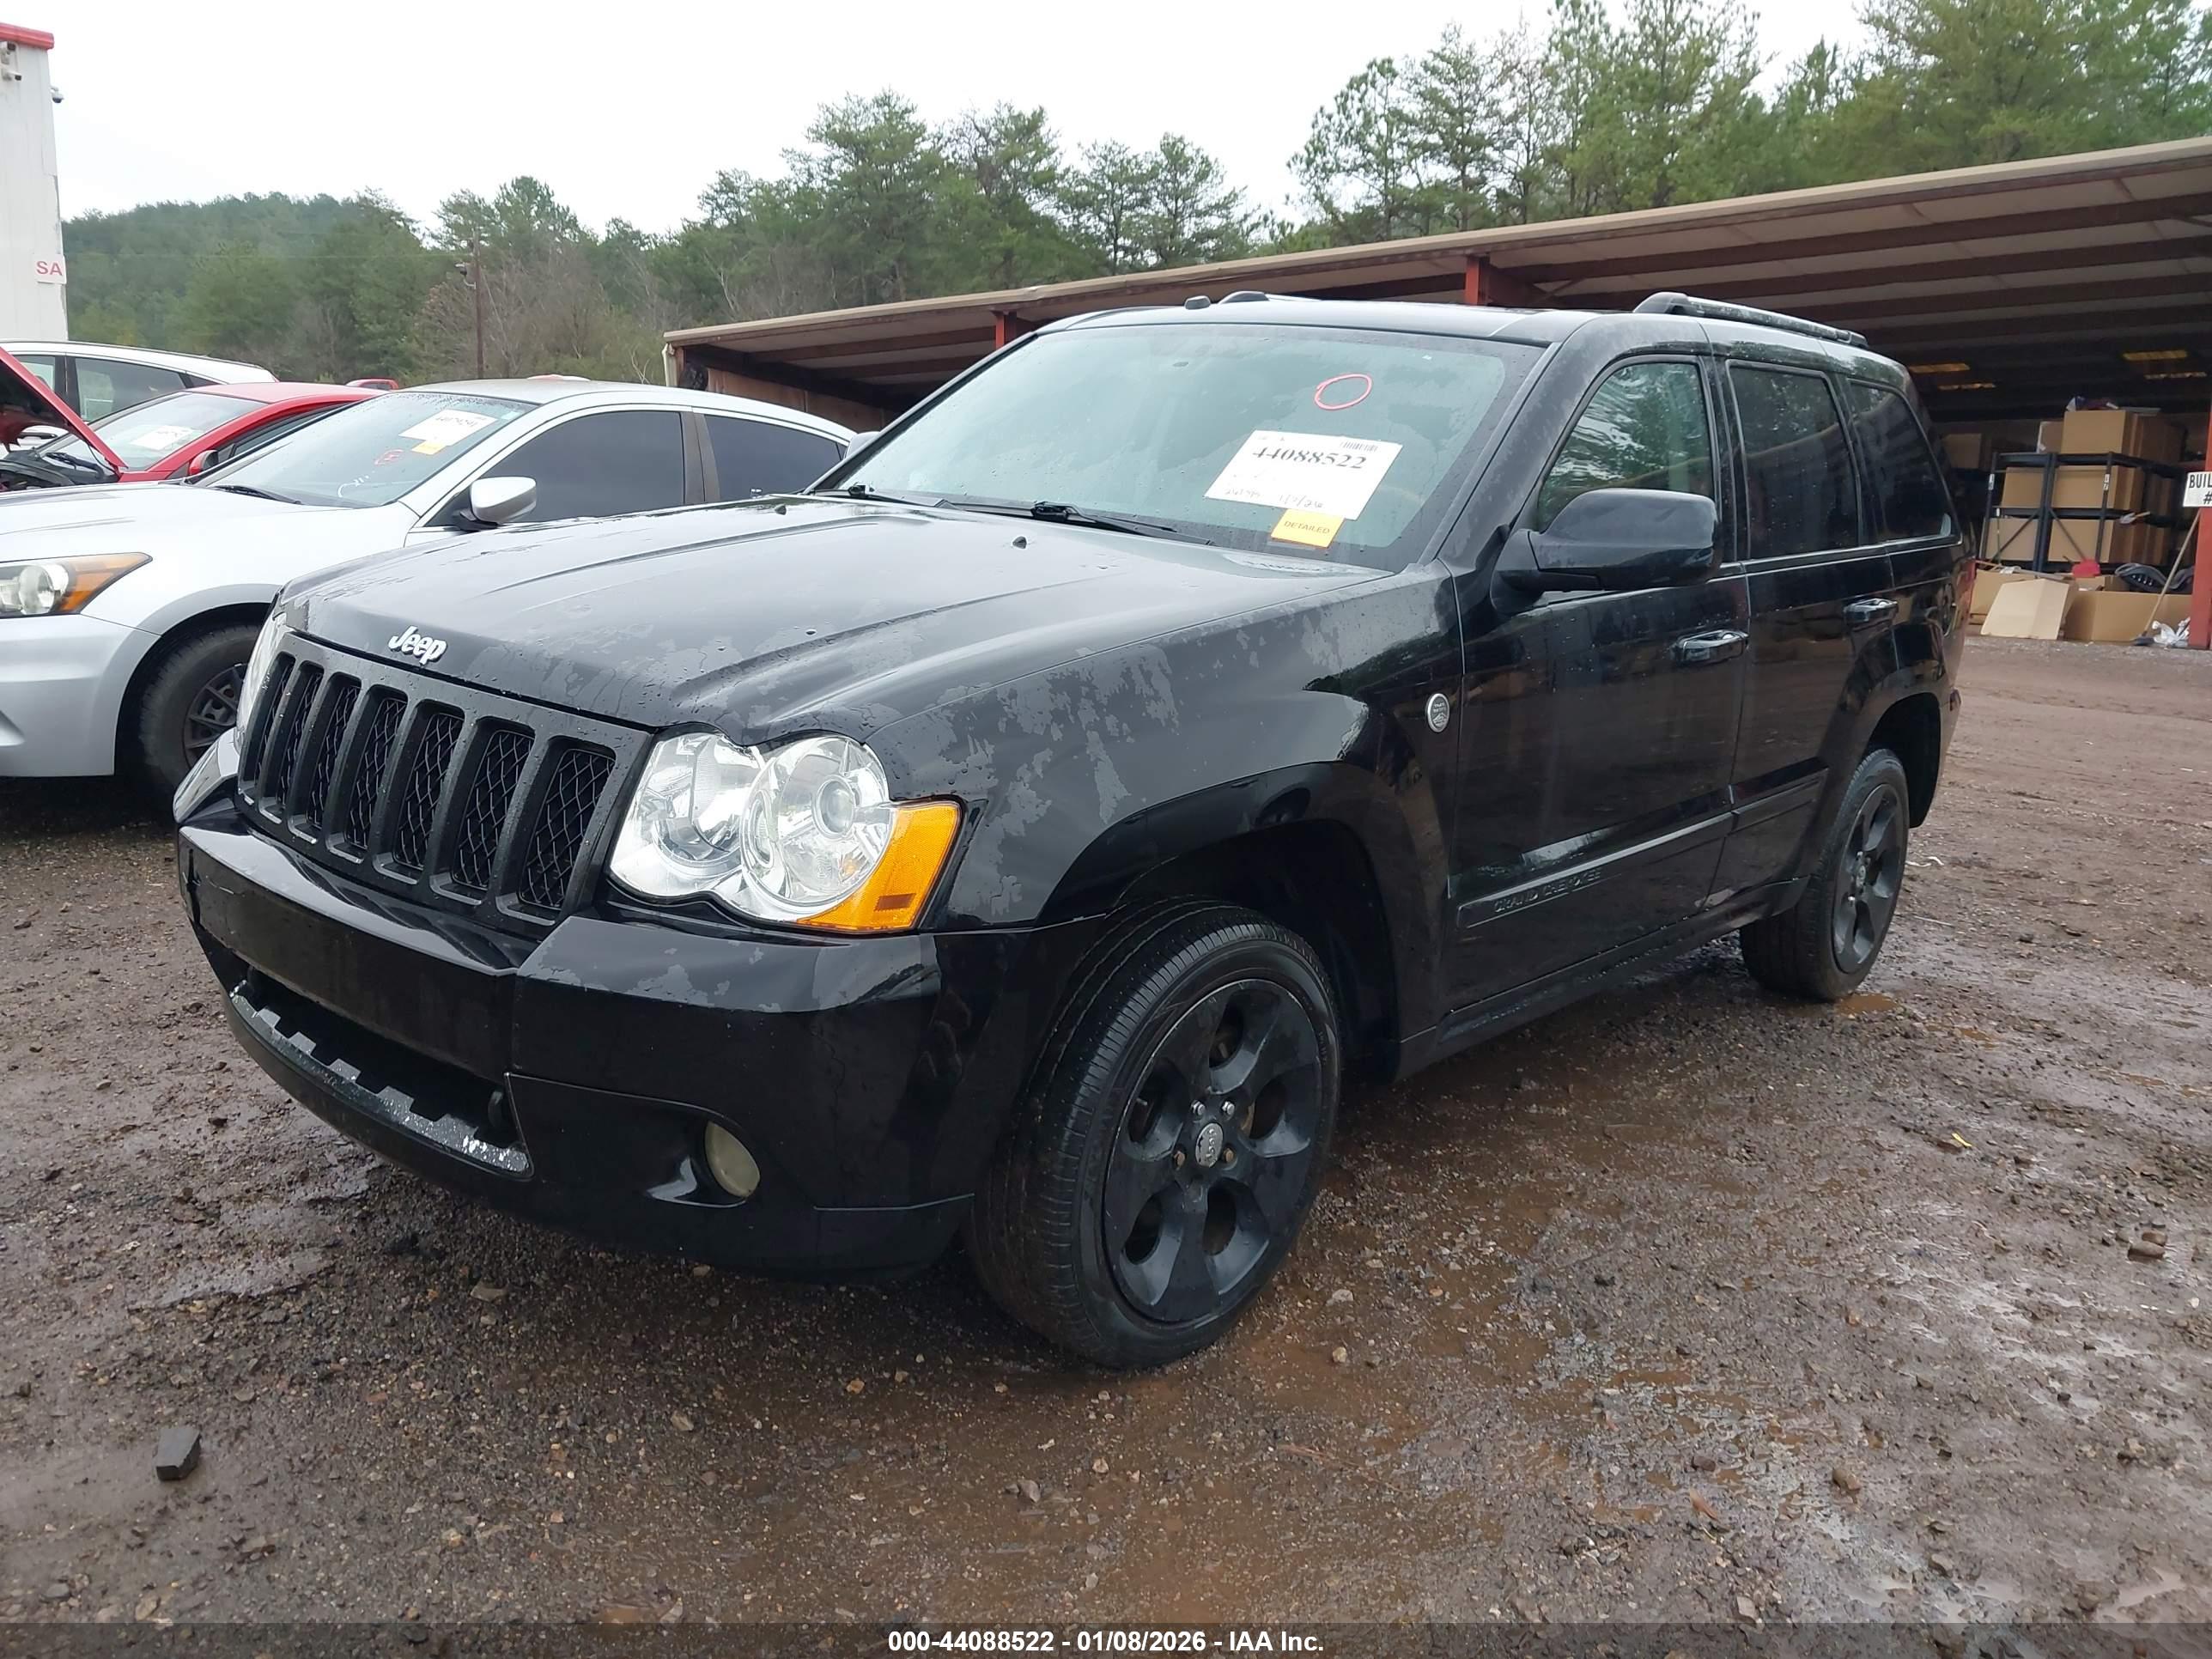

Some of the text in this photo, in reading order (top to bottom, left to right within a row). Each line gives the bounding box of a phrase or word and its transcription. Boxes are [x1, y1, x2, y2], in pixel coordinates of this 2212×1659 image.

[1252, 446, 1367, 470] 44088522
[1284, 520, 1331, 534] DETAILED
[388, 625, 448, 666] Jeep
